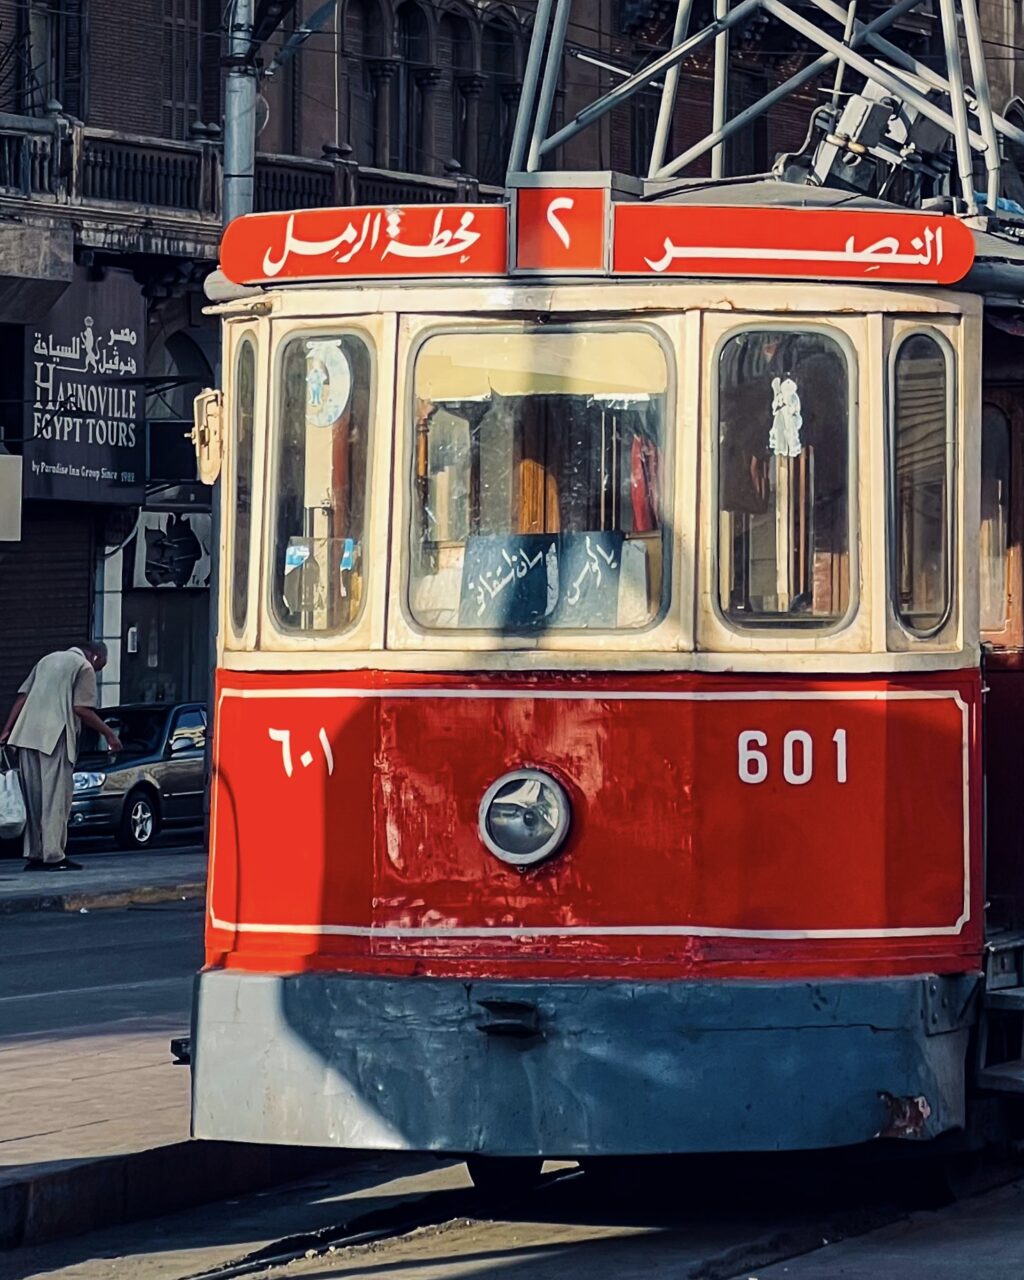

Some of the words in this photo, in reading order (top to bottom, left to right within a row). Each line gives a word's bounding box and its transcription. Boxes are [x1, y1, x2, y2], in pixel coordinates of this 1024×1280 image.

[263, 212, 381, 276] الرمل
[381, 208, 481, 263] محطة
[546, 197, 573, 249] ٢
[644, 226, 943, 272] النصر
[34, 332, 80, 362] للسياحة
[108, 328, 137, 345] مصر
[33, 362, 136, 419] HANNOVILLE
[33, 412, 83, 443] EGYPT
[86, 419, 136, 448] TOURS
[32, 460, 40, 475] by
[41, 462, 68, 474] Paradise
[69, 465, 80, 476] Inn
[81, 466, 100, 481] Group
[101, 468, 117, 479] Since
[268, 727, 335, 777] ٦٠١
[737, 729, 848, 785] 601
